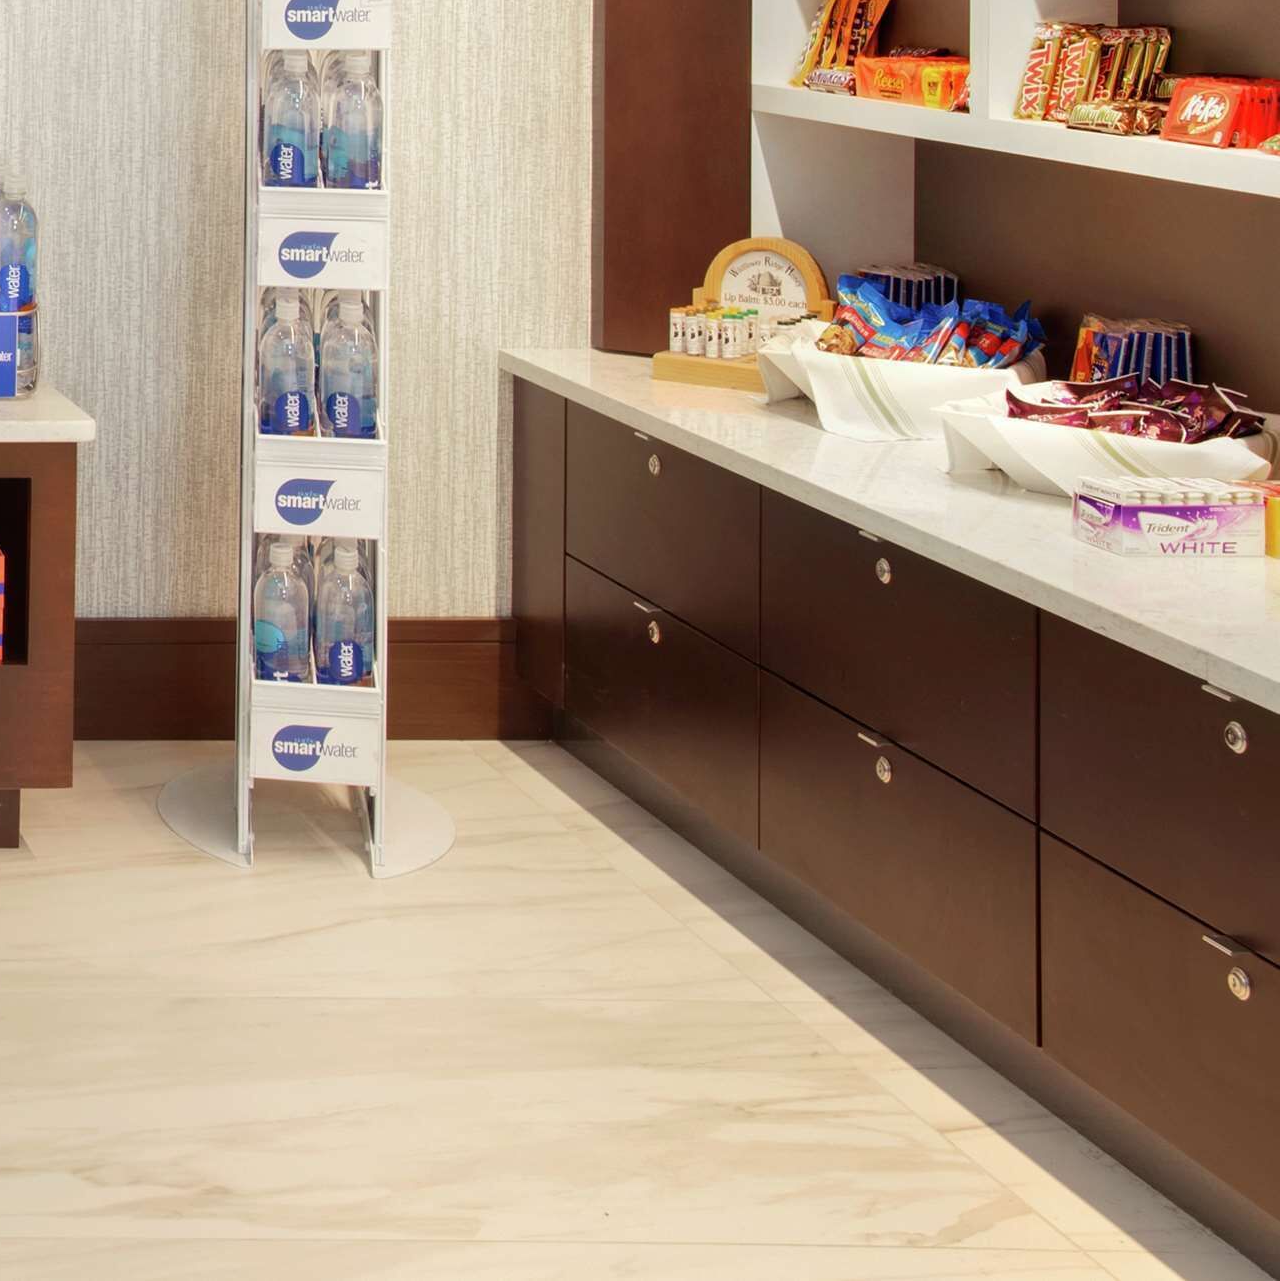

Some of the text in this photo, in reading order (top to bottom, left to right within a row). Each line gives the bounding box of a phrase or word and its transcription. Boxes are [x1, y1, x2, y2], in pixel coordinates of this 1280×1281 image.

[287, 7, 371, 24] smartwater
[280, 144, 293, 180] water
[280, 247, 365, 263] smartwater
[8, 264, 21, 299] water
[288, 393, 300, 427] water
[335, 394, 348, 428] water
[277, 494, 361, 511] smartwater
[1146, 522, 1190, 534] Trident
[1160, 541, 1238, 554] WHITE
[340, 643, 354, 677] water
[273, 739, 358, 758] smartwater
